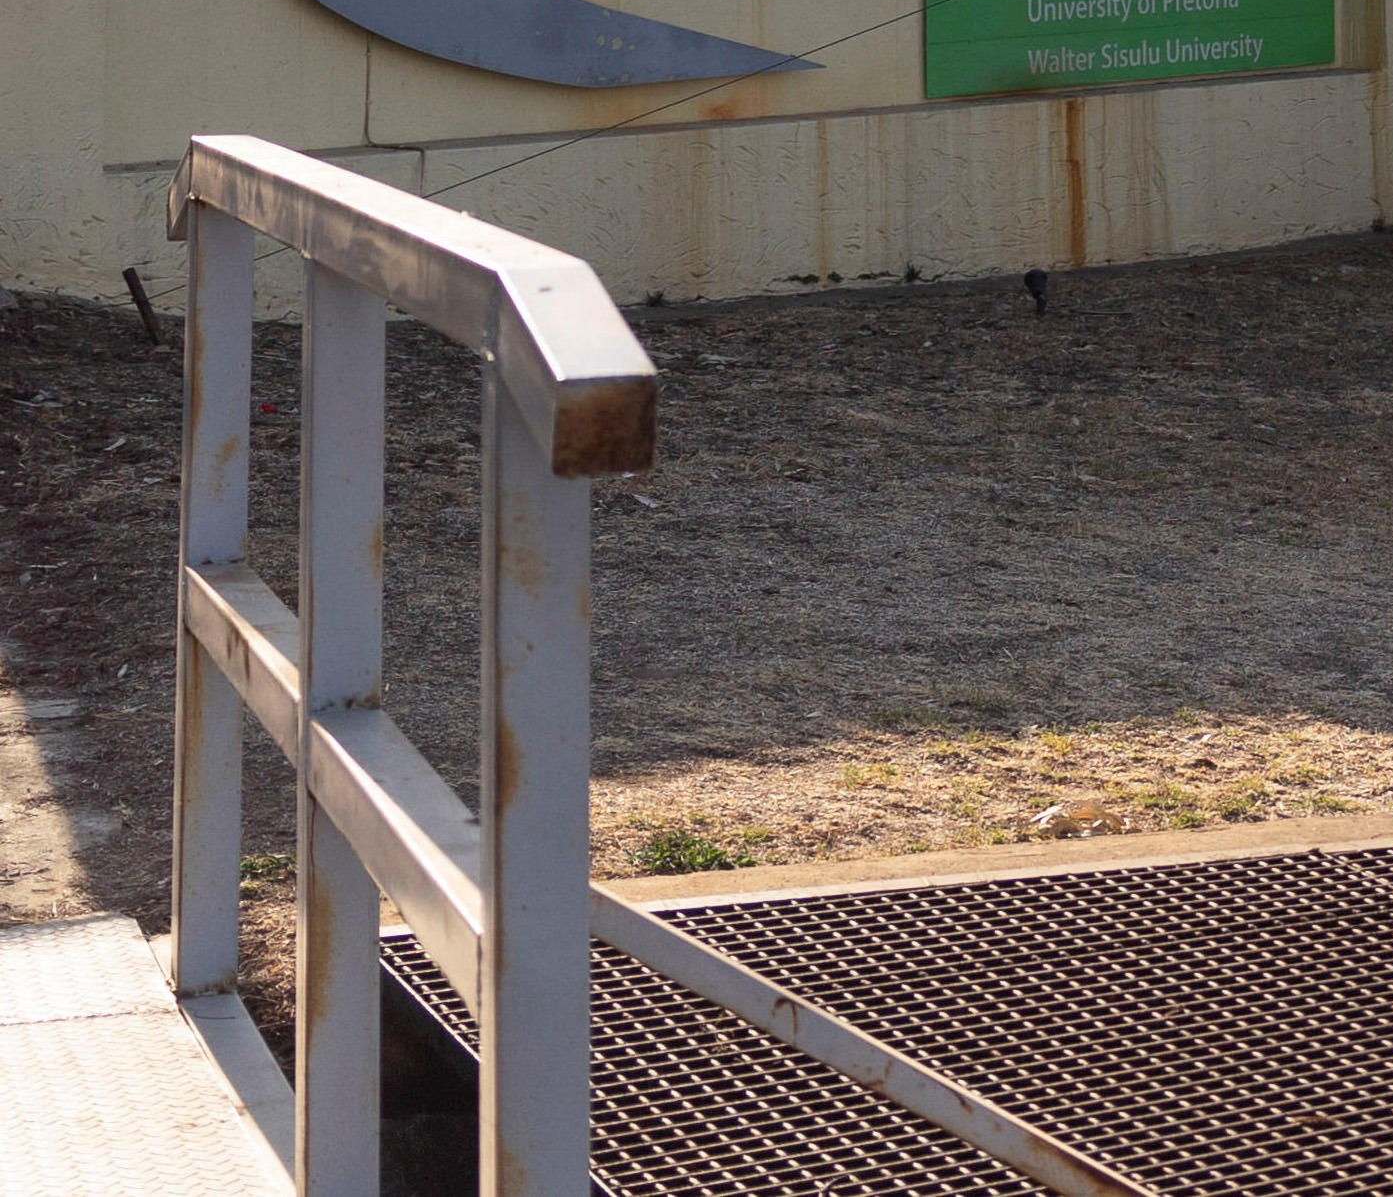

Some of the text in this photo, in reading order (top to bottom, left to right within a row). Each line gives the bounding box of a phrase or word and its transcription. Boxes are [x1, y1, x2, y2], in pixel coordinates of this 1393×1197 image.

[1028, 33, 1263, 74] Walter Sisulu University
